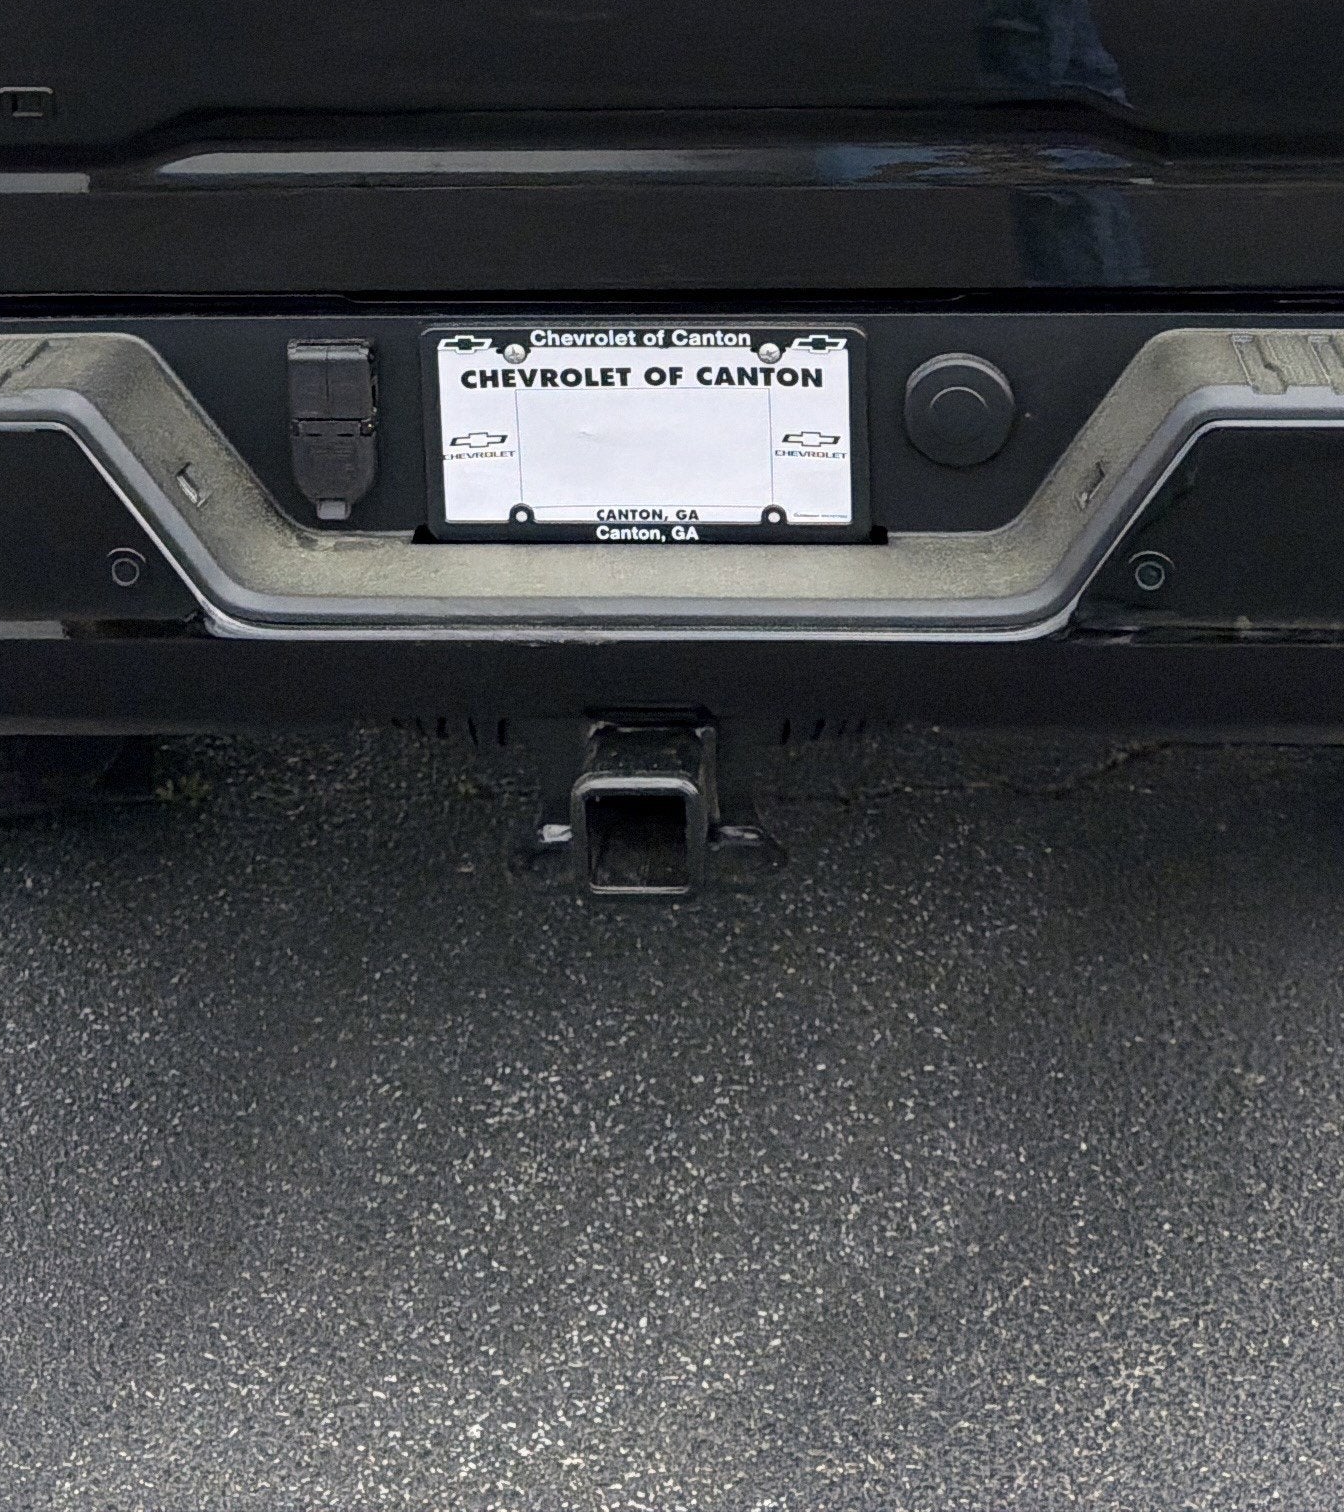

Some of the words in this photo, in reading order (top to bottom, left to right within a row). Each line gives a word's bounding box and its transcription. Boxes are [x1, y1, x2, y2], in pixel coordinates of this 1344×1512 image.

[529, 329, 637, 347] Chevrolet
[643, 329, 666, 347] of
[671, 329, 752, 347] Canton
[460, 367, 632, 389] CHEVROLET
[643, 366, 684, 387] OF
[696, 366, 823, 388] CANTON
[443, 450, 516, 461] CHEVROLET
[774, 449, 848, 460] CHEVROLET
[596, 508, 669, 522] CANTON,
[676, 509, 700, 521] GA
[596, 525, 667, 543] Canton,
[671, 525, 700, 541] GA
